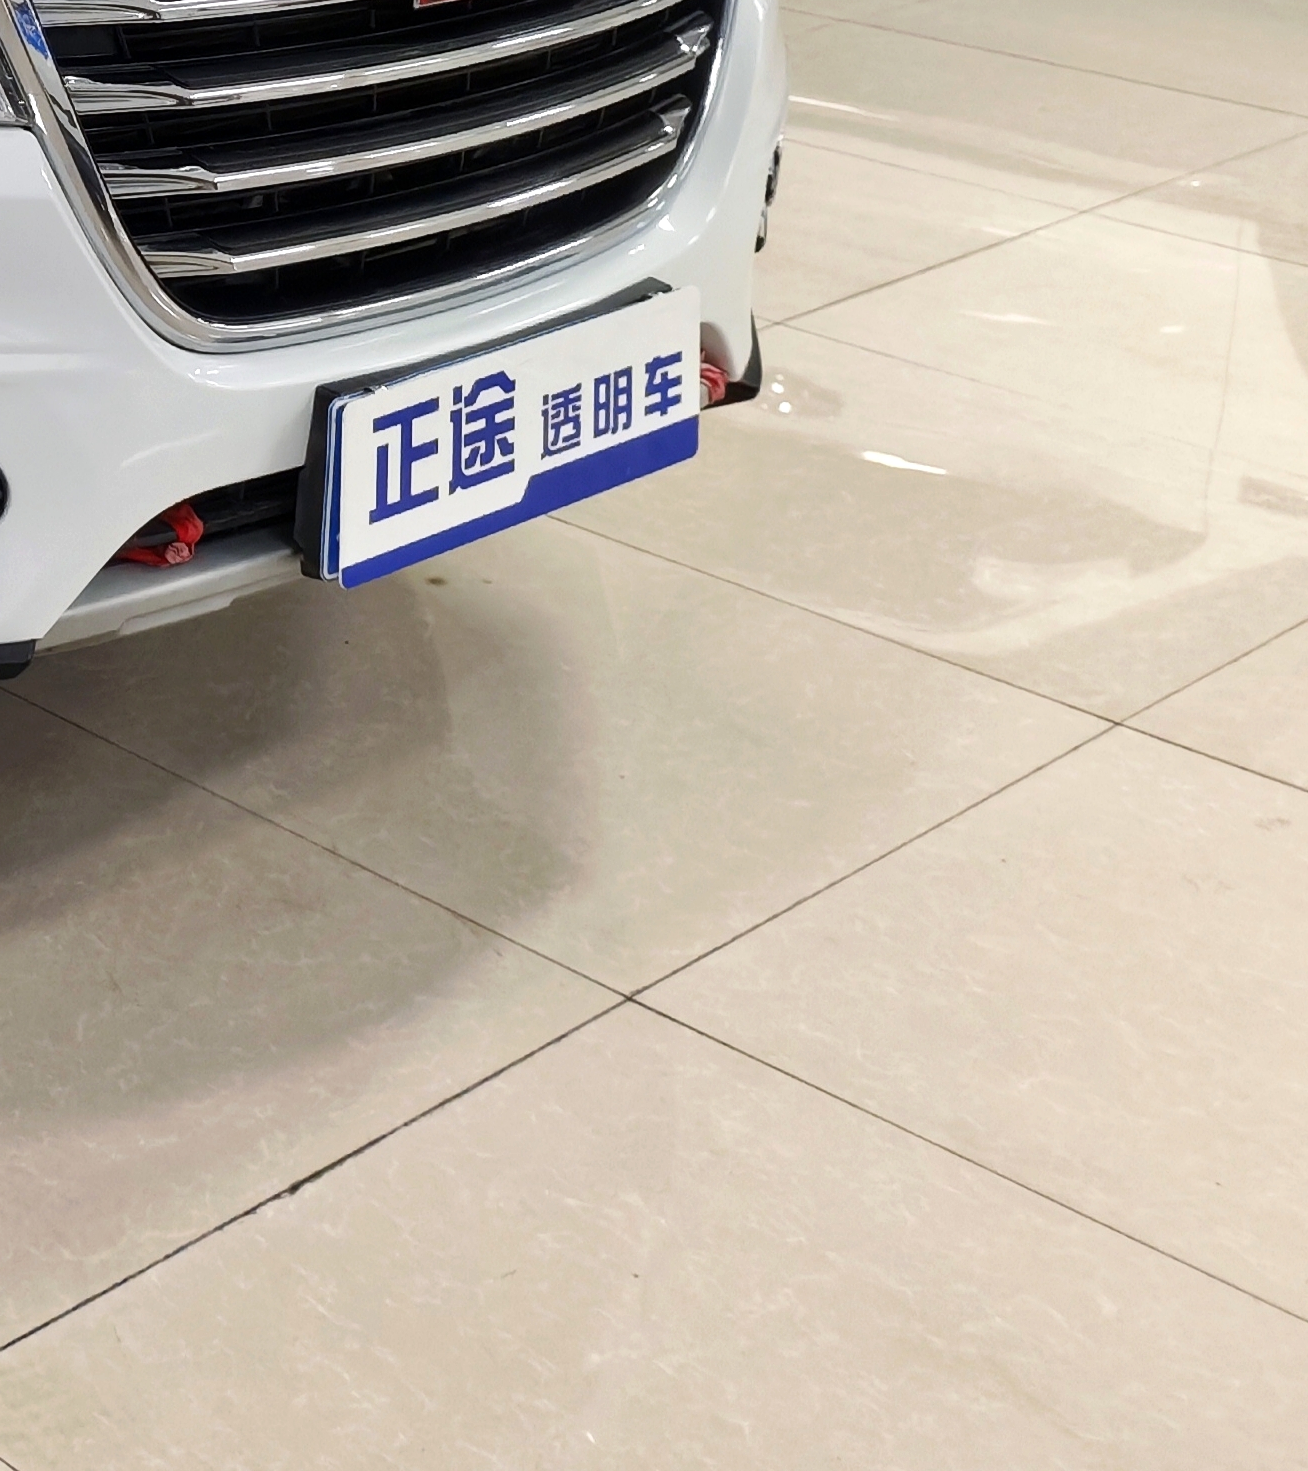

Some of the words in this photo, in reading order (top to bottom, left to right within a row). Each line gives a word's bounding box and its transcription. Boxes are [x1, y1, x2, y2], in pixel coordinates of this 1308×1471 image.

[369, 370, 517, 526] 正途
[540, 350, 683, 461] 透明车
